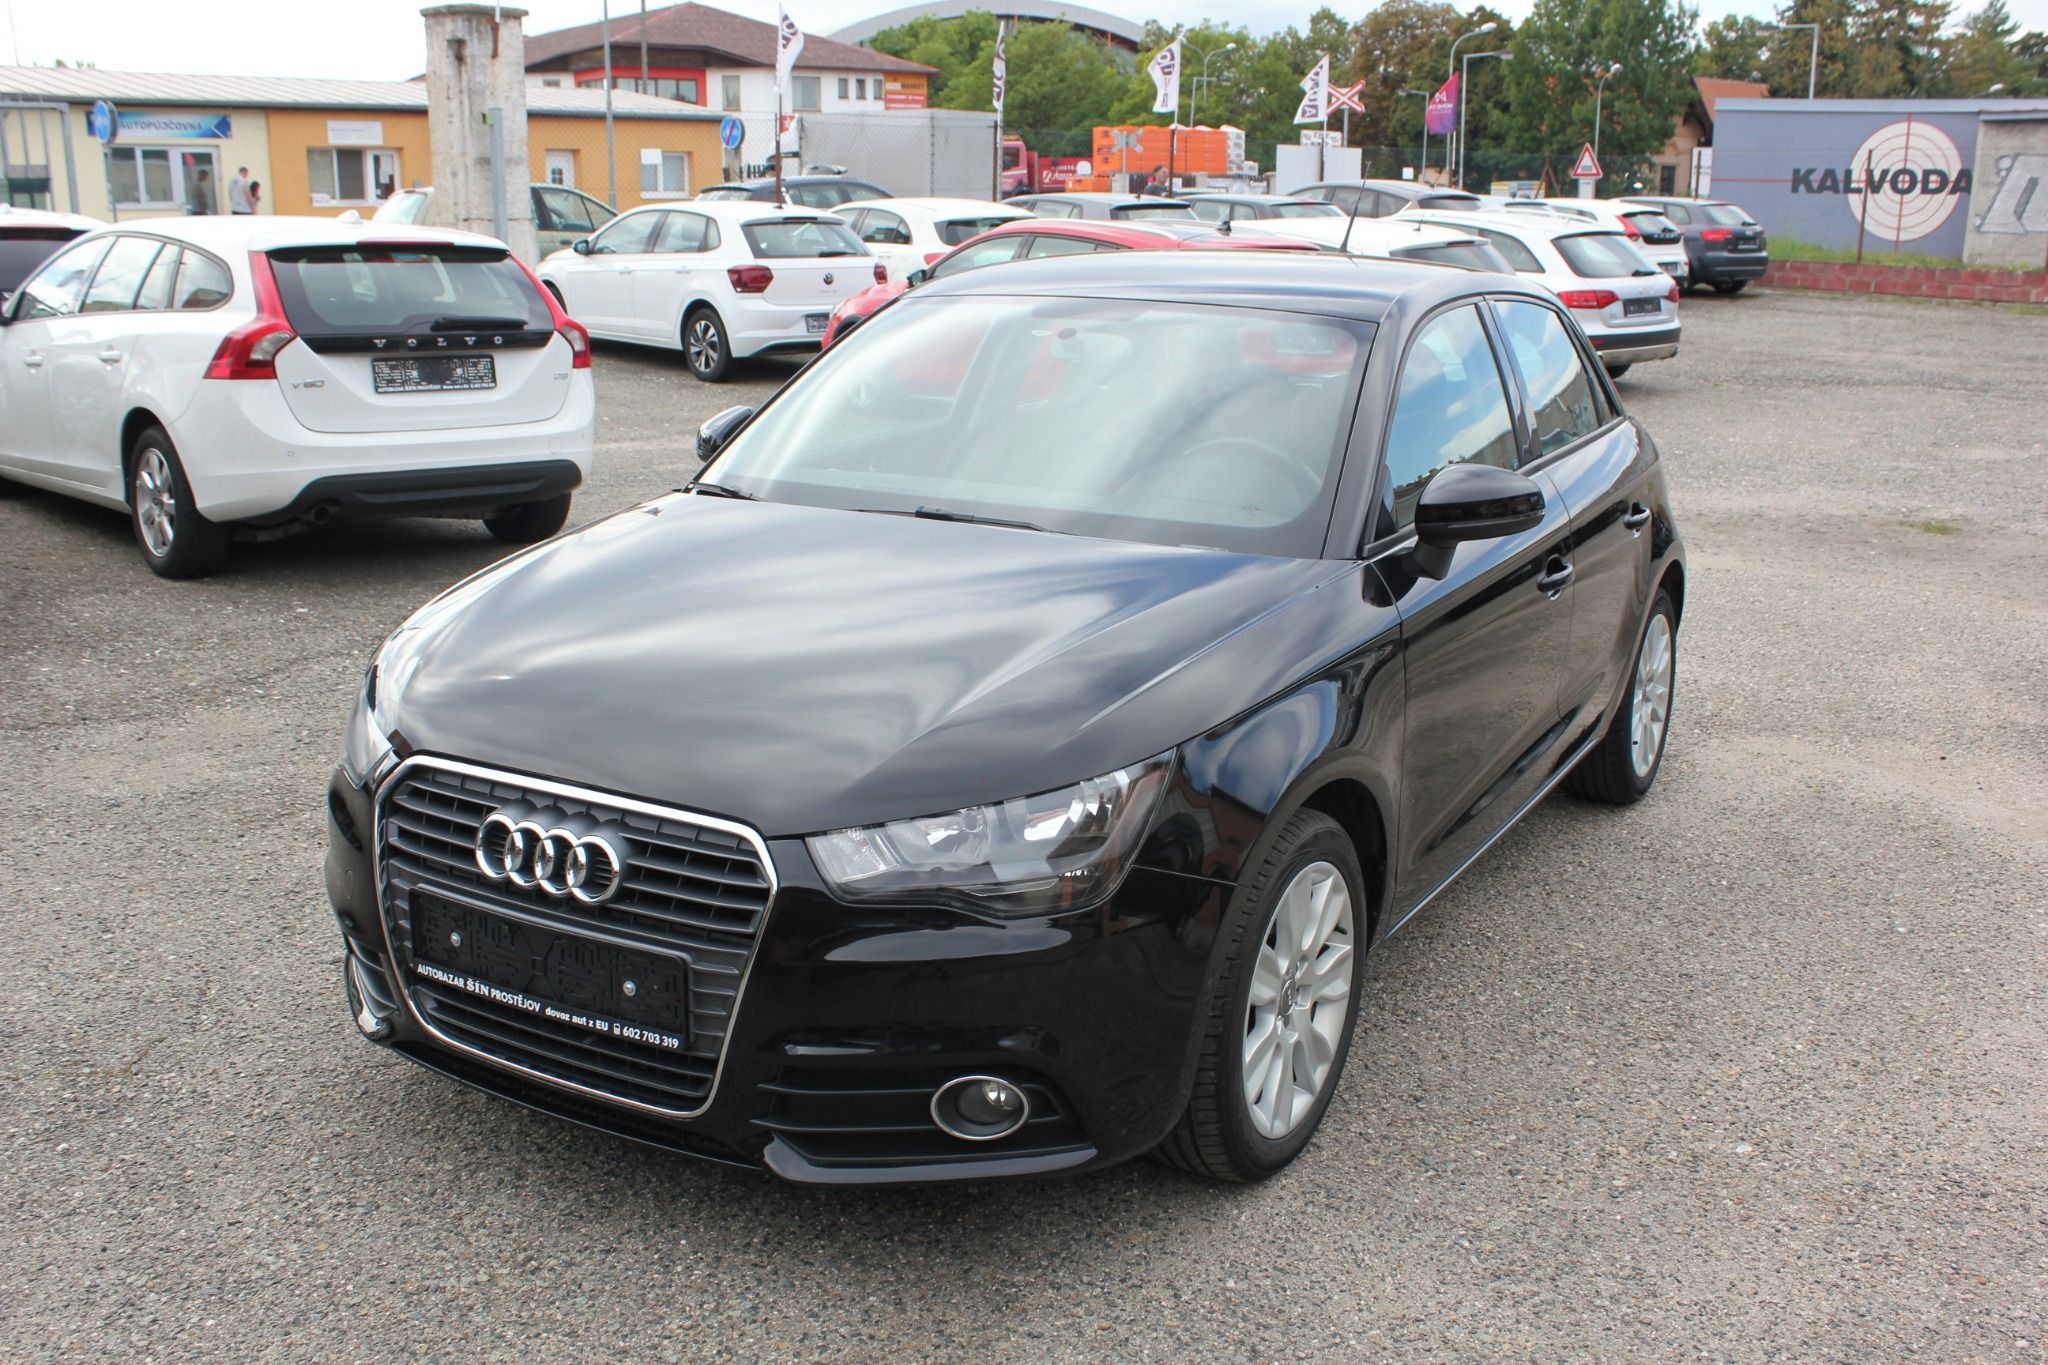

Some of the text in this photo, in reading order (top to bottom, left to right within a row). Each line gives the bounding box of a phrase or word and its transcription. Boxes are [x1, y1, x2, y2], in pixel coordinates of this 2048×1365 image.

[1791, 167, 1973, 195] KALVODA
[373, 336, 503, 348] VOLVO
[417, 963, 679, 1049] AUTOBAZAR ŠÍN PROSTĚJOV dovoz aut z EU 602 703 319
